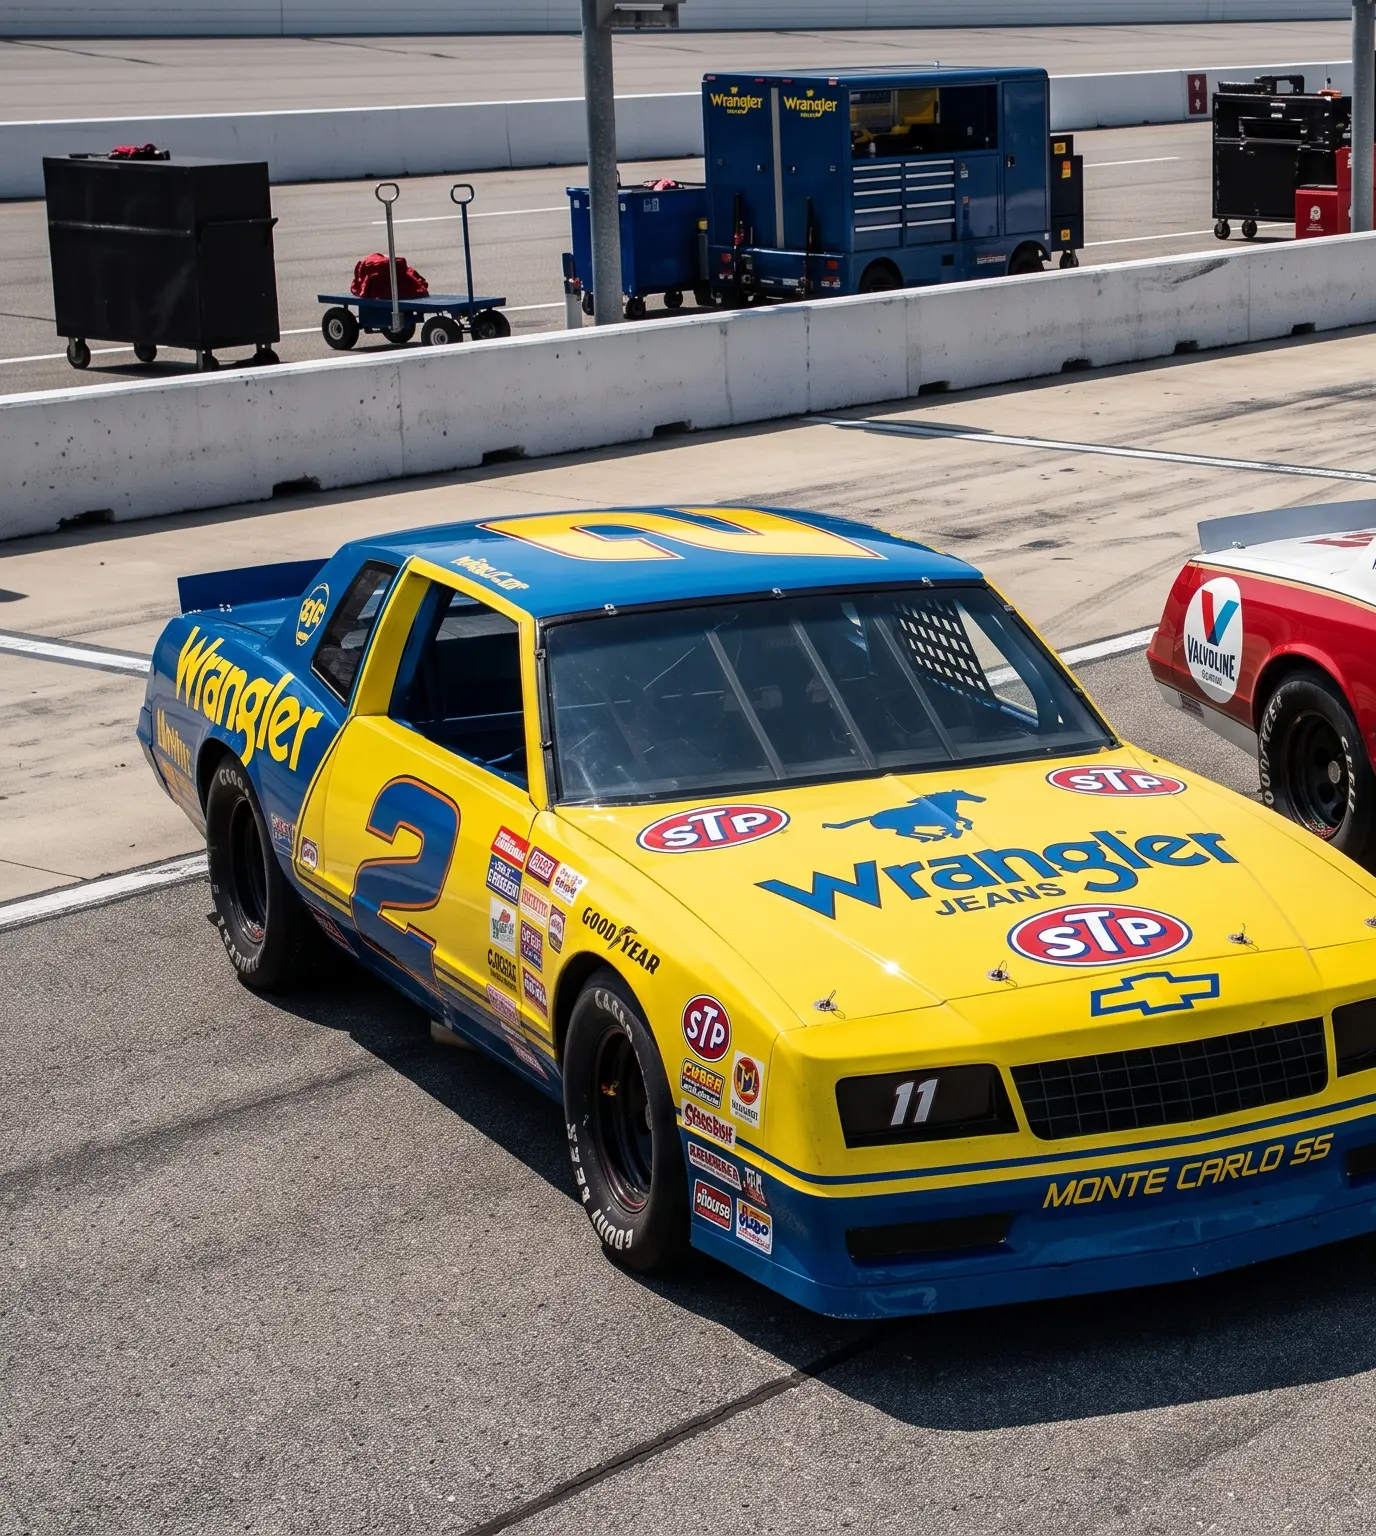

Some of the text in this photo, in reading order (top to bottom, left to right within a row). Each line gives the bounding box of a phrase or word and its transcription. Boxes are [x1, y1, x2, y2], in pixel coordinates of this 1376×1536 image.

[474, 506, 889, 562] 2
[1187, 634, 1236, 682] VALVOLINE
[176, 625, 324, 772] Wrangler
[1068, 768, 1165, 792] STP
[661, 809, 772, 848] STP
[351, 774, 461, 997] 2
[753, 830, 1240, 921] Wrangler
[935, 882, 1067, 916] JEANS
[1037, 910, 1168, 959] STP
[686, 1004, 726, 1050] STP
[890, 1078, 938, 1126] 11
[1042, 1133, 1335, 1208] MONTE CARLO SS
